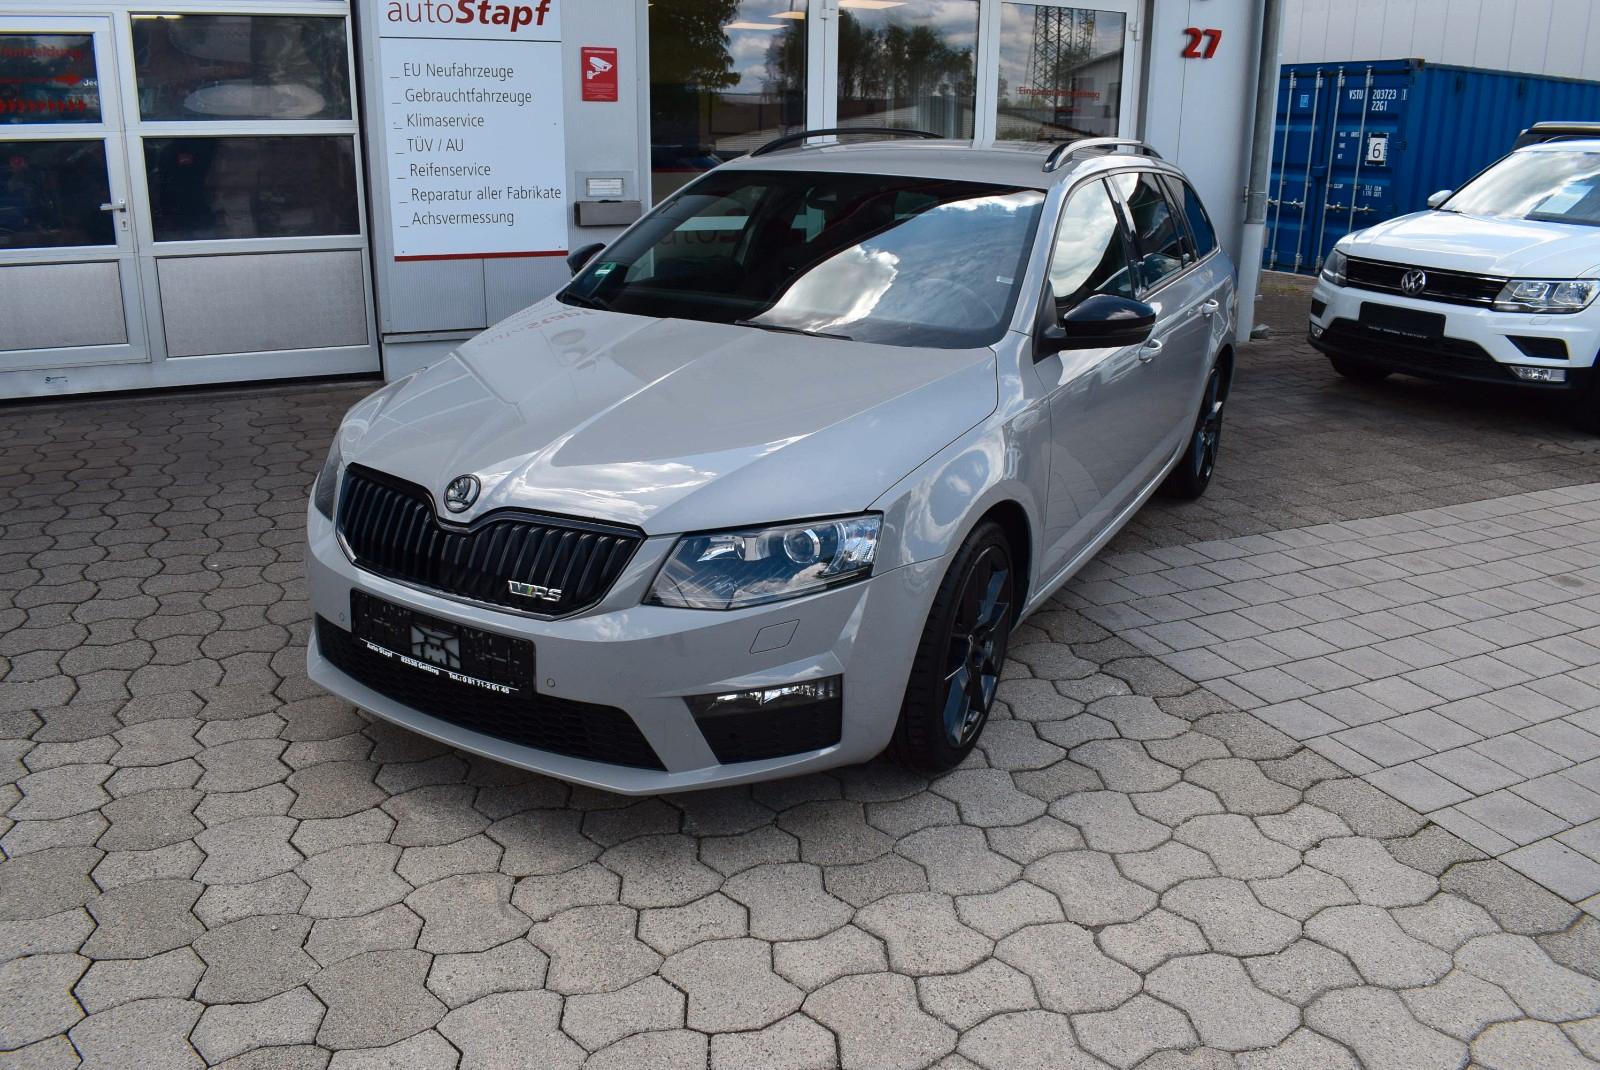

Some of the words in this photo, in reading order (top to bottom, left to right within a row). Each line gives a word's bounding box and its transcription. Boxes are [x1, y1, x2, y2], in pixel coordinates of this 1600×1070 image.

[387, 0, 551, 32] autoStapf
[1182, 28, 1222, 59] 27
[403, 63, 421, 77] EU
[426, 63, 514, 81] Neufahrzeuge
[405, 88, 532, 106] Gebrauchtfahrzeuge
[1349, 89, 1364, 100] VSTU
[1372, 89, 1397, 100] 203723
[406, 113, 485, 127] Klimaservice
[407, 136, 433, 152] TÜV
[437, 138, 443, 152] /
[445, 138, 464, 152] AU
[1373, 143, 1382, 159] 6
[409, 163, 491, 177] Reifenservice
[411, 188, 472, 204] Reparatur
[476, 187, 502, 200] aller
[507, 185, 562, 199] Fabrikate
[412, 211, 514, 226] Achsvermessung
